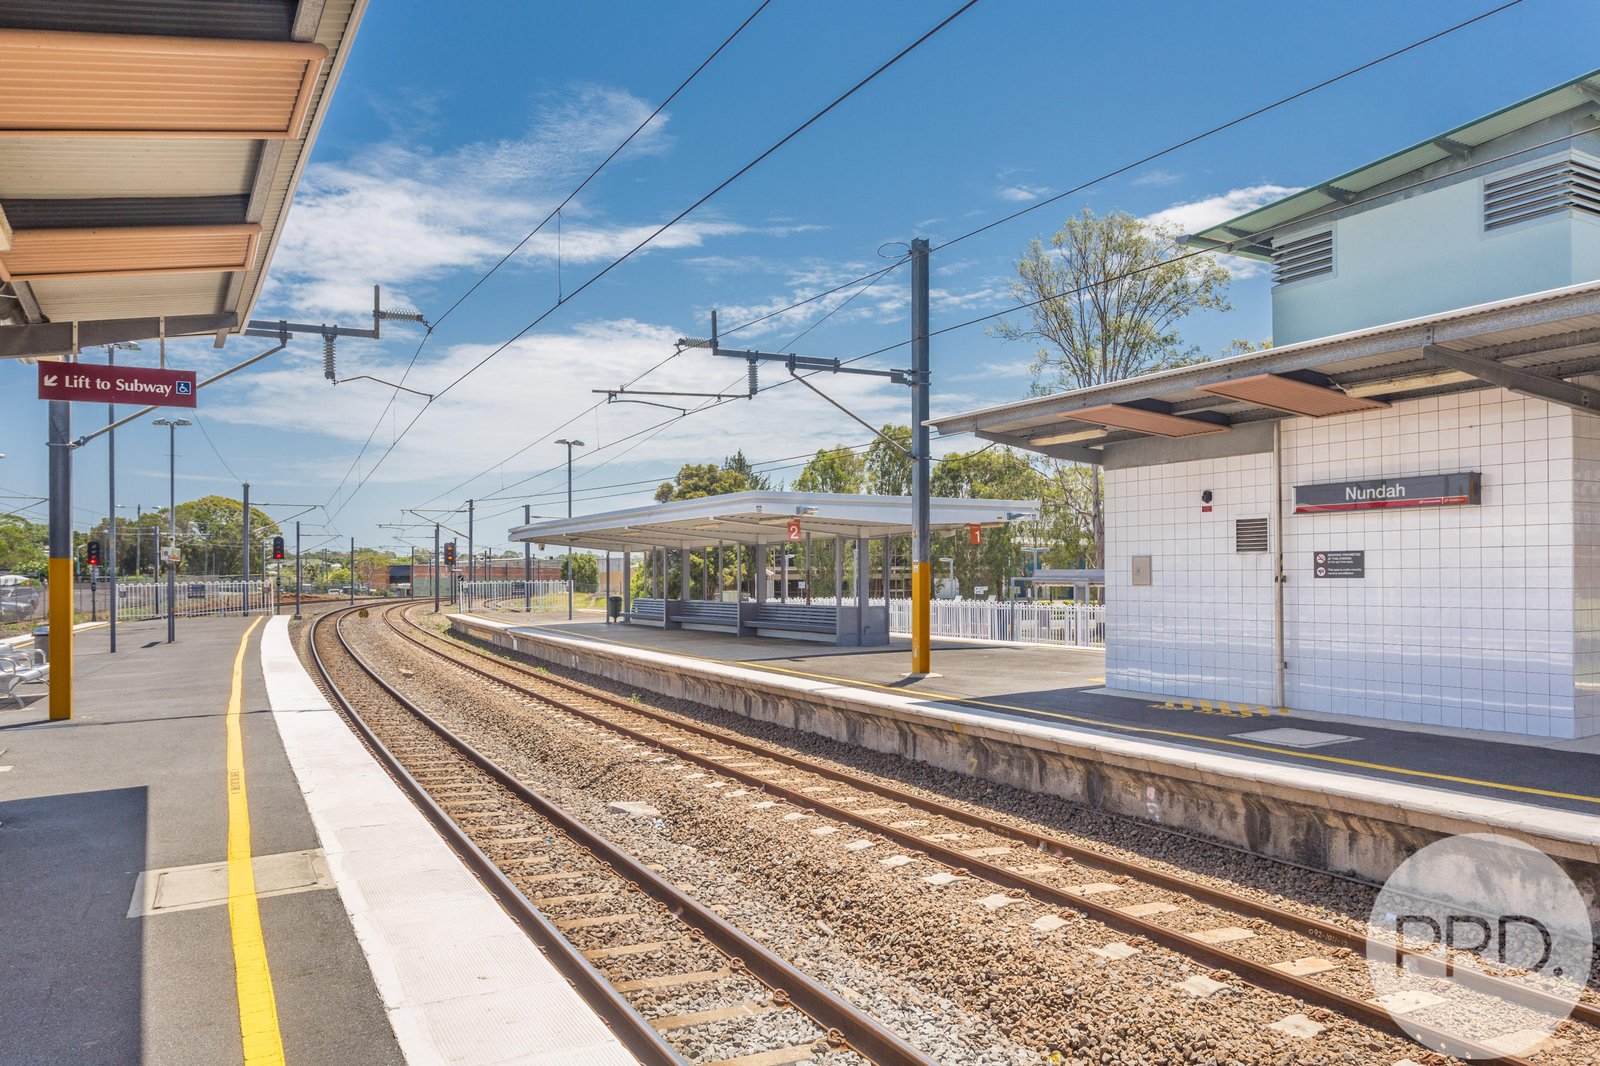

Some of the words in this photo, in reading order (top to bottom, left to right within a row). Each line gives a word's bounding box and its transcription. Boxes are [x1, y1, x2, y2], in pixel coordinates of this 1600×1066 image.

[64, 375, 91, 389] Lift
[95, 378, 111, 390] to
[115, 378, 172, 397] Subway
[1345, 483, 1406, 501] Nundah
[790, 525, 799, 539] 2
[975, 530, 980, 543] 1
